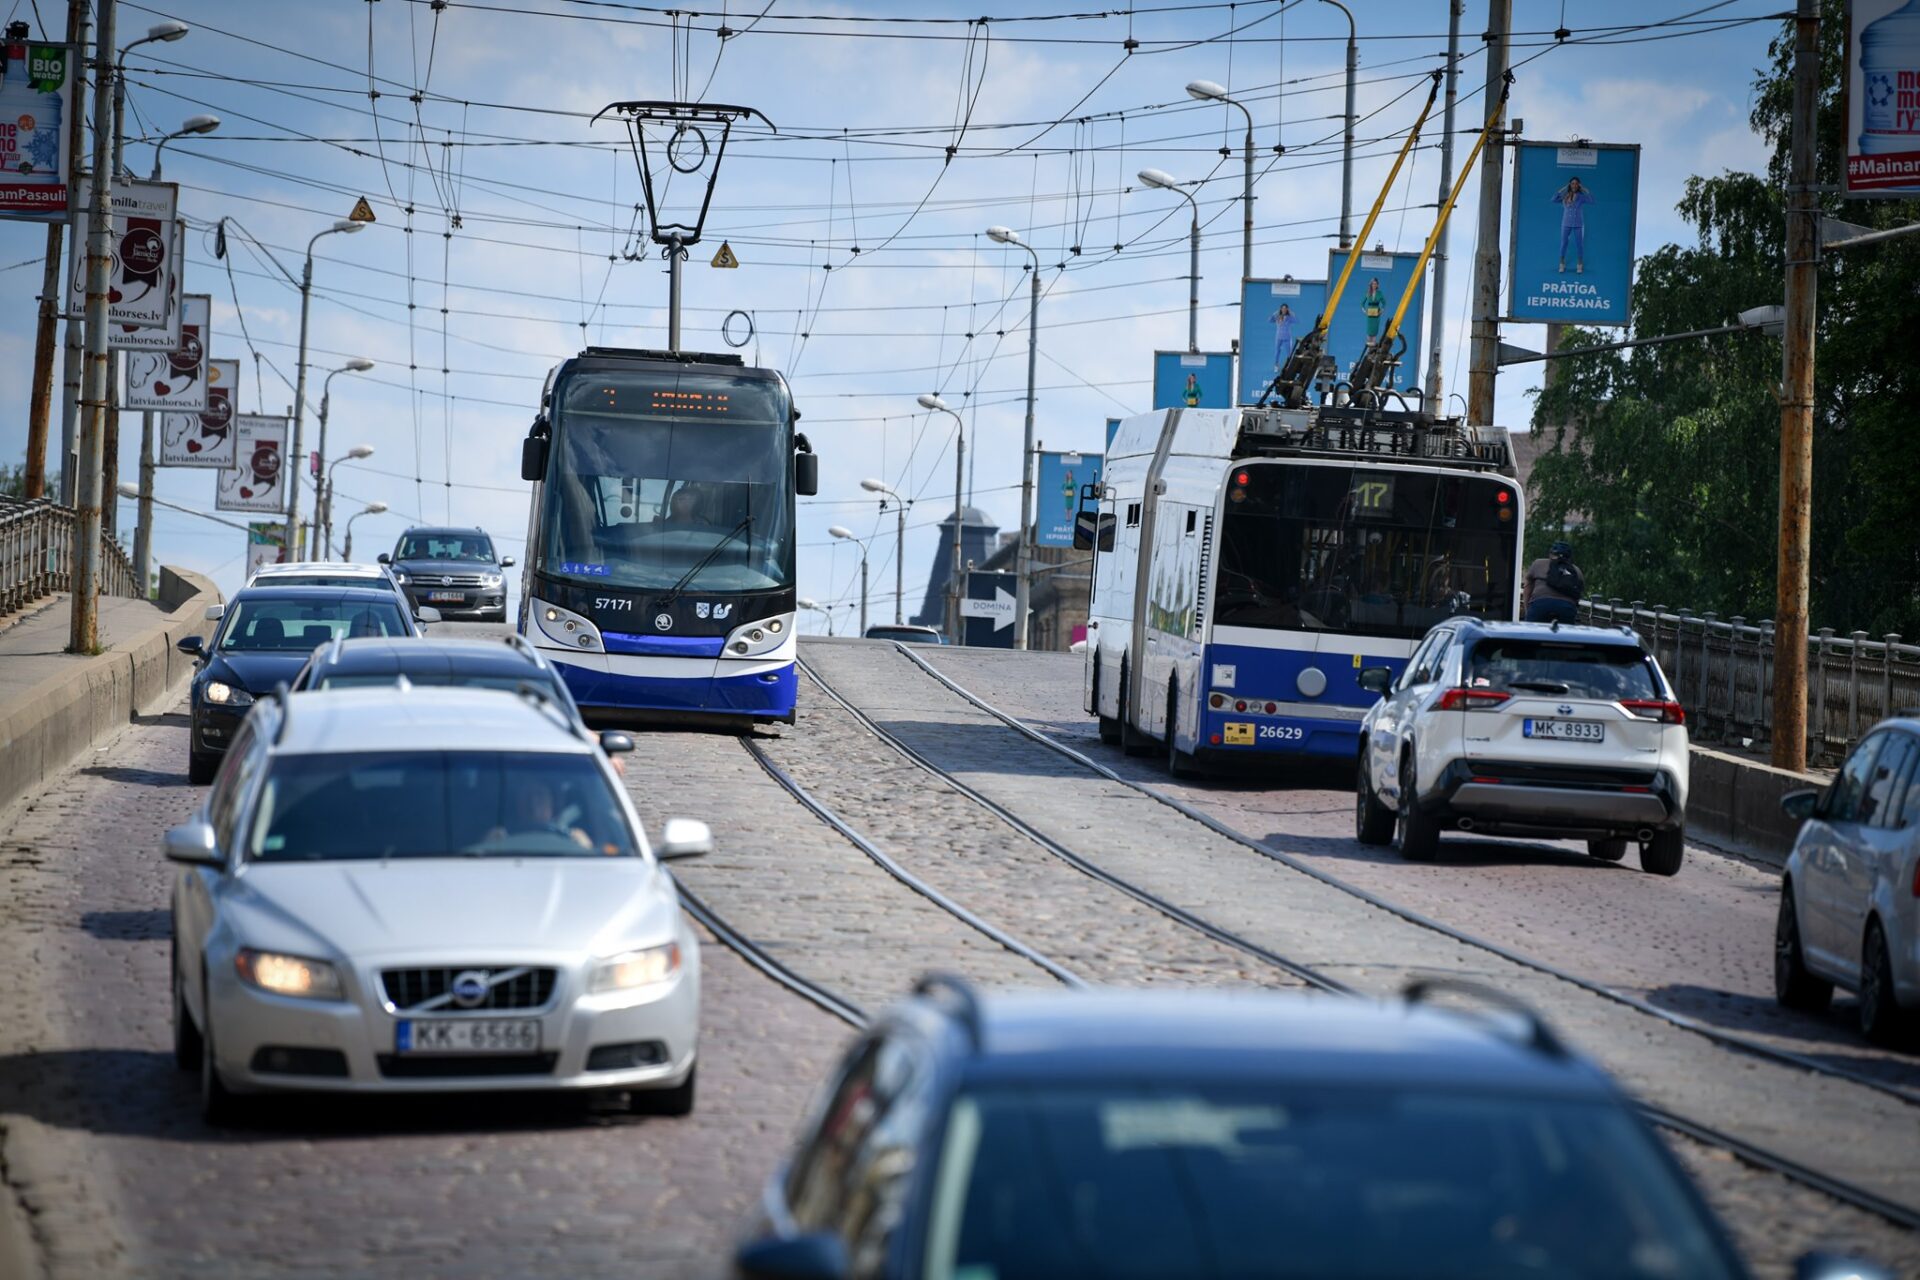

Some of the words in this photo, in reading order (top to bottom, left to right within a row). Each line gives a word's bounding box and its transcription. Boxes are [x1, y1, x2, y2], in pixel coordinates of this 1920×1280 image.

[32, 58, 62, 73] BIO
[32, 72, 61, 81] water
[1542, 280, 1597, 295] PRĀTĪGA
[1527, 295, 1611, 310] IEPIRKŠANĀS
[108, 334, 177, 346] vianhorses.lv
[130, 396, 203, 408] latvianhorses.lv
[165, 454, 232, 464] latvianhorses.lv
[1358, 482, 1388, 507] 17
[594, 598, 632, 611] 57171
[973, 602, 1012, 611] DOMINA
[1259, 725, 1303, 740] 26629
[1534, 719, 1601, 738] MK-8933
